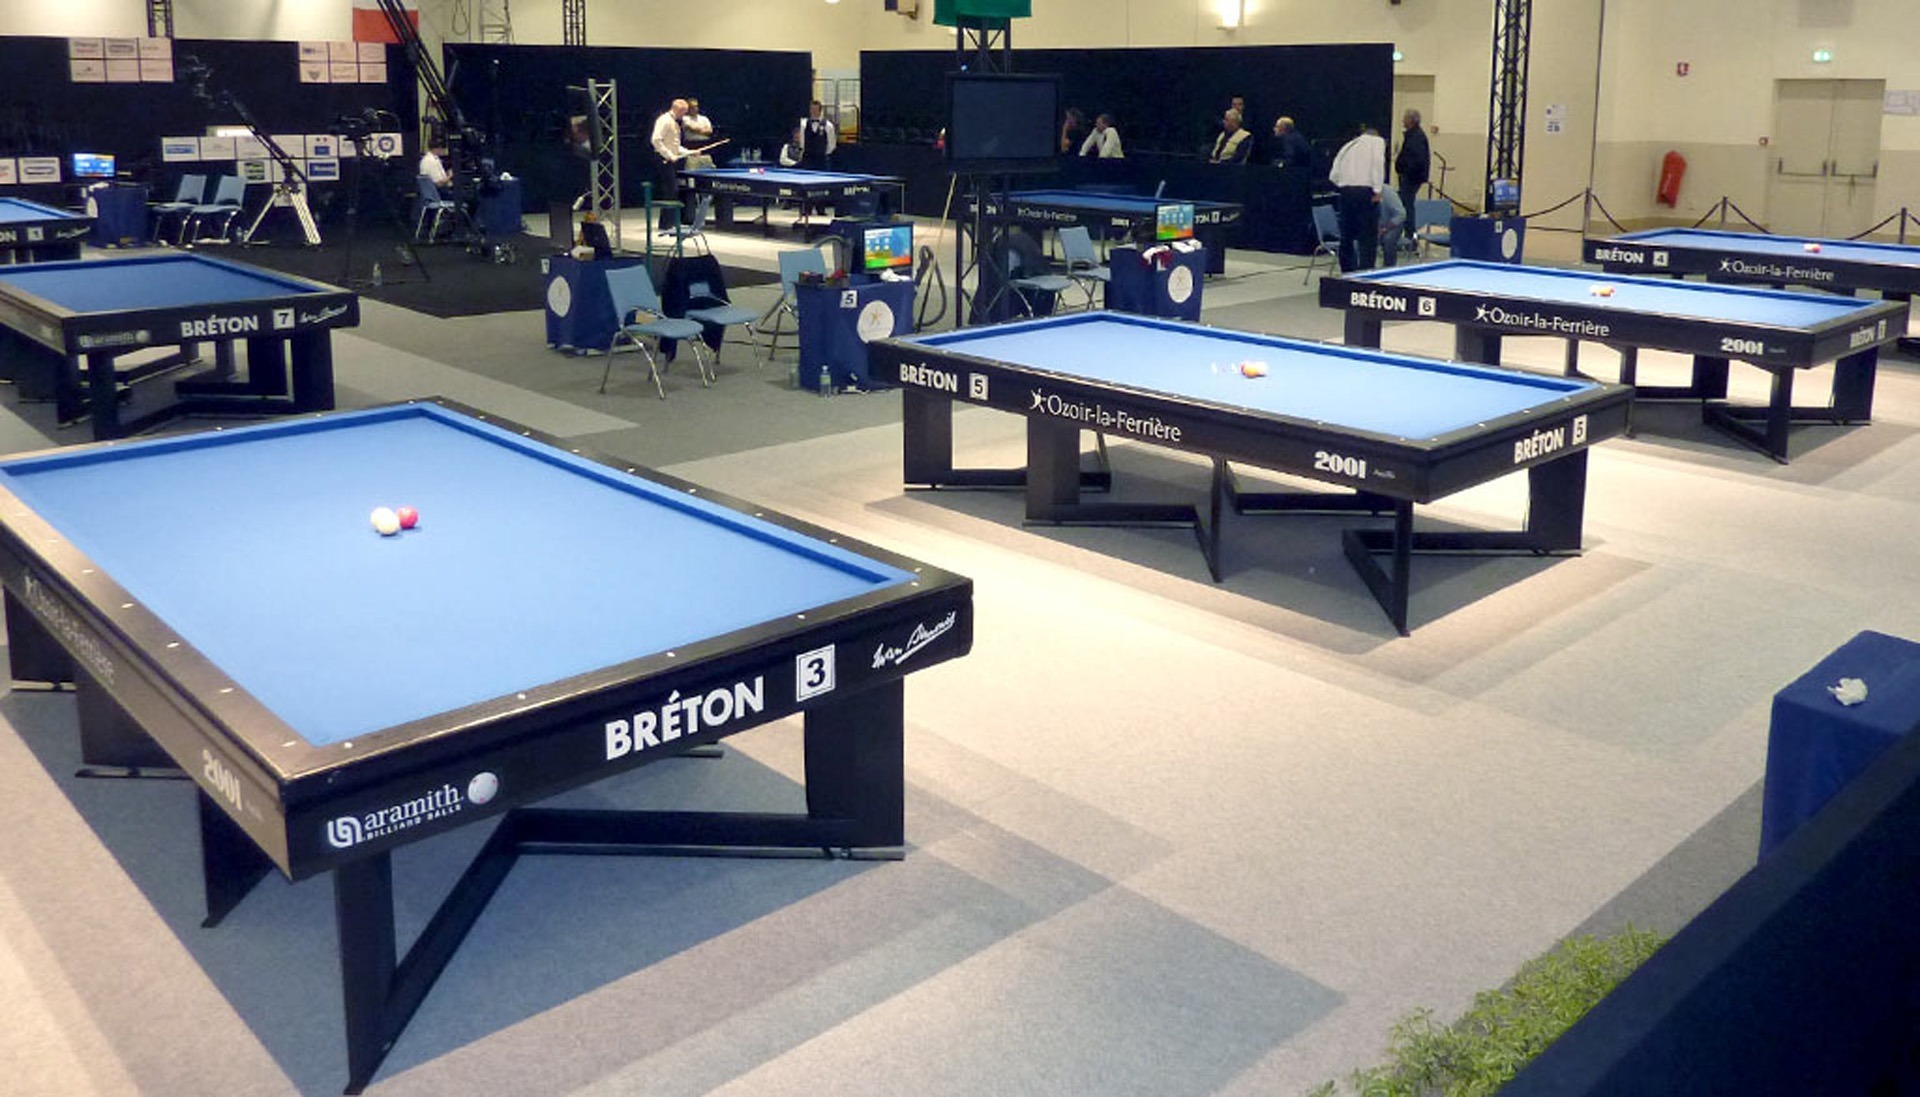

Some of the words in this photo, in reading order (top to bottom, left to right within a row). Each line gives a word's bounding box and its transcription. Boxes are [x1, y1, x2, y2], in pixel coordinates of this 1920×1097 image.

[1595, 248, 1644, 264] BRÉTON
[1351, 290, 1407, 312] BRÉTON
[180, 314, 259, 338] BRÉTON
[1489, 306, 1610, 337] Ozoir-la-Ferrière
[1720, 337, 1764, 356] 2001
[900, 362, 958, 393] BRÉTON
[1047, 394, 1182, 442] Ozoir-la-Ferrière
[1514, 426, 1565, 464] BRÉTON
[1313, 449, 1367, 479] 2001
[605, 675, 764, 761] BRÉTON
[363, 783, 460, 831] aramith
[365, 816, 423, 841] BILLIARD
